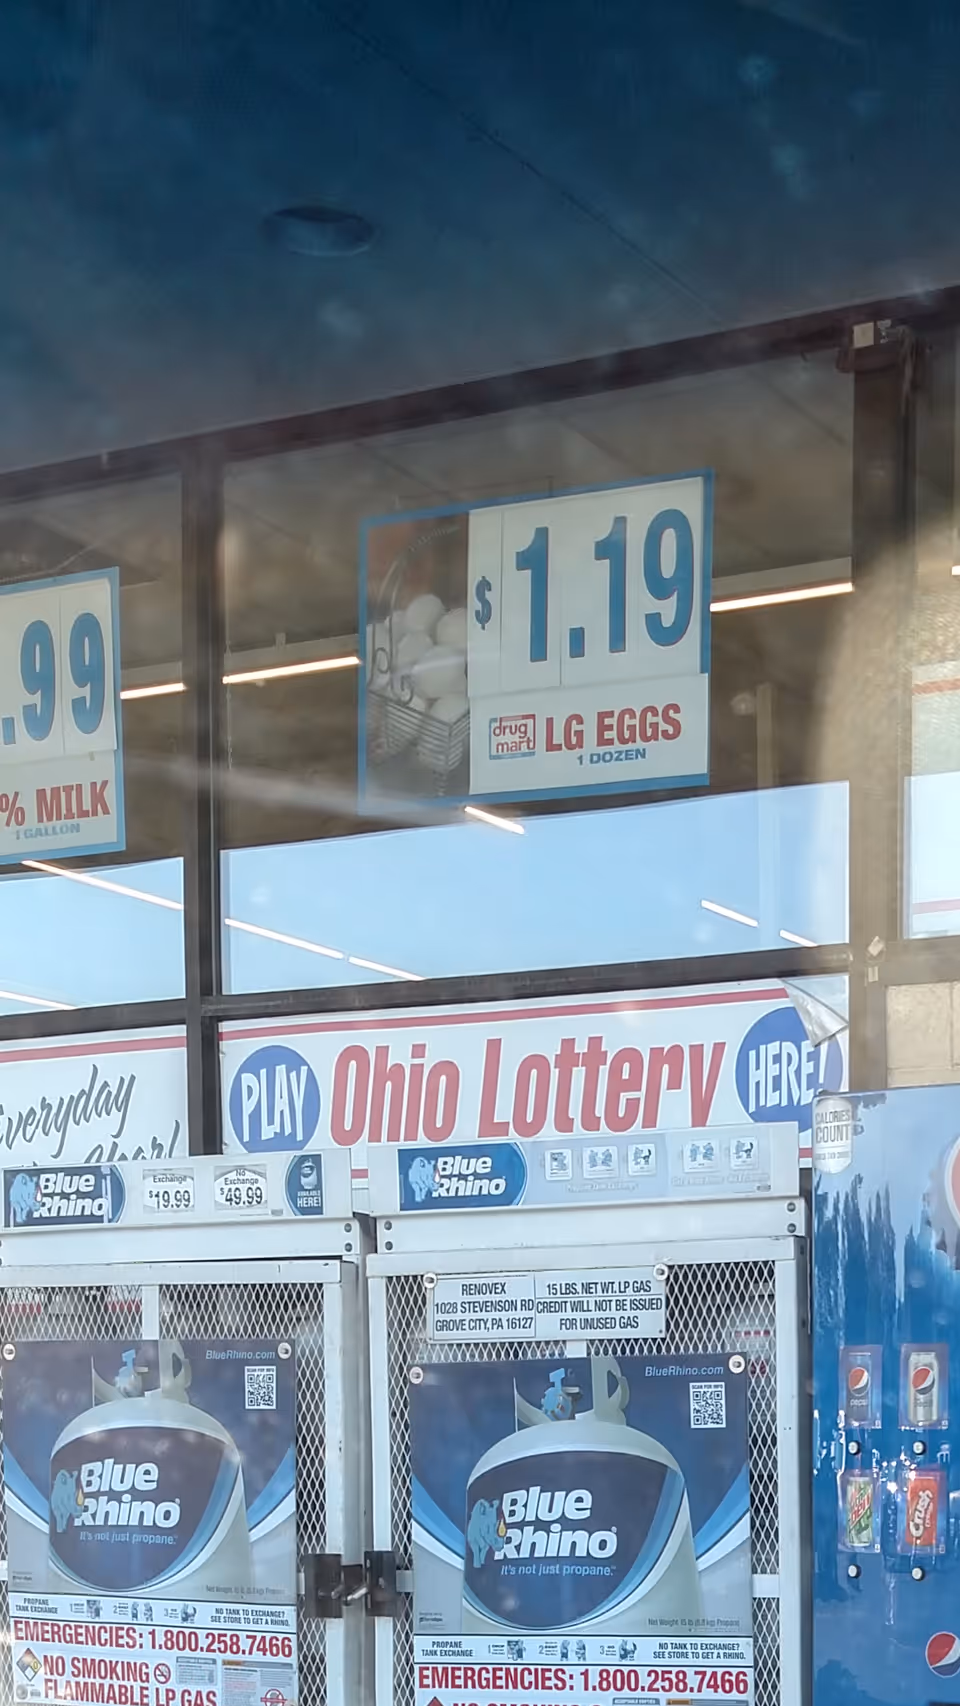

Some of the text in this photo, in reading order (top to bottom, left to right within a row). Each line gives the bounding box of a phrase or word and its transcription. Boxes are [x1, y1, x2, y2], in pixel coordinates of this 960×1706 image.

[493, 720, 528, 738] drug
[546, 703, 682, 752] LG EGGS
[496, 736, 532, 753] mart
[577, 748, 646, 766] 1 DOZEN
[35, 779, 110, 824] MILK
[23, 822, 81, 840] GALLON
[330, 1035, 727, 1147] Ohio Lottery
[241, 1063, 308, 1142] PLAY
[816, 1124, 850, 1144] COUNT
[235, 1169, 246, 1177] No
[437, 1156, 492, 1175] Blue
[39, 1173, 95, 1194] Blue
[153, 1174, 187, 1185] Exchange
[224, 1176, 259, 1186] Exchange
[432, 1176, 506, 1197] Rhino
[149, 1189, 191, 1210] $19.99
[220, 1186, 263, 1207] $49.99
[33, 1195, 106, 1218] Rhino
[461, 1282, 506, 1296] RENOVEX
[546, 1280, 652, 1296] 15 LBS. NET WT. LP GAS
[434, 1299, 534, 1314] 1028 STEVENSON RD
[536, 1297, 662, 1314] CREDIT WILL NOT BE ISSUED
[435, 1317, 467, 1332] GROVE
[505, 1316, 534, 1330] 16127
[559, 1316, 639, 1331] FOR UNUSED GAS
[206, 1350, 275, 1360] BlueRhino.com
[645, 1365, 724, 1377] BlueRhino.com
[80, 1458, 159, 1493] Blue
[74, 1493, 180, 1528] Rhino
[502, 1486, 593, 1524] Blue
[95, 1532, 110, 1541] not
[111, 1531, 130, 1543] just
[494, 1523, 618, 1561] Rhino
[501, 1564, 516, 1575] It's
[518, 1564, 536, 1575] not
[538, 1564, 560, 1577] just
[13, 1619, 293, 1658] EMERGENCIES: 1.800.258.7466
[431, 1641, 463, 1649] PROPANE
[658, 1642, 740, 1652] NO TANK TO EXCHANGE?
[421, 1649, 474, 1658] TANK EXCHANGE
[652, 1651, 667, 1660] SEE
[667, 1652, 691, 1660] STORE
[691, 1652, 700, 1660] TO
[701, 1652, 715, 1660] GET
[716, 1652, 722, 1660] A
[43, 1655, 66, 1677] NO
[71, 1656, 150, 1684] SMOKING
[418, 1666, 749, 1695] EMERGENCIES: 1.800.258.7466
